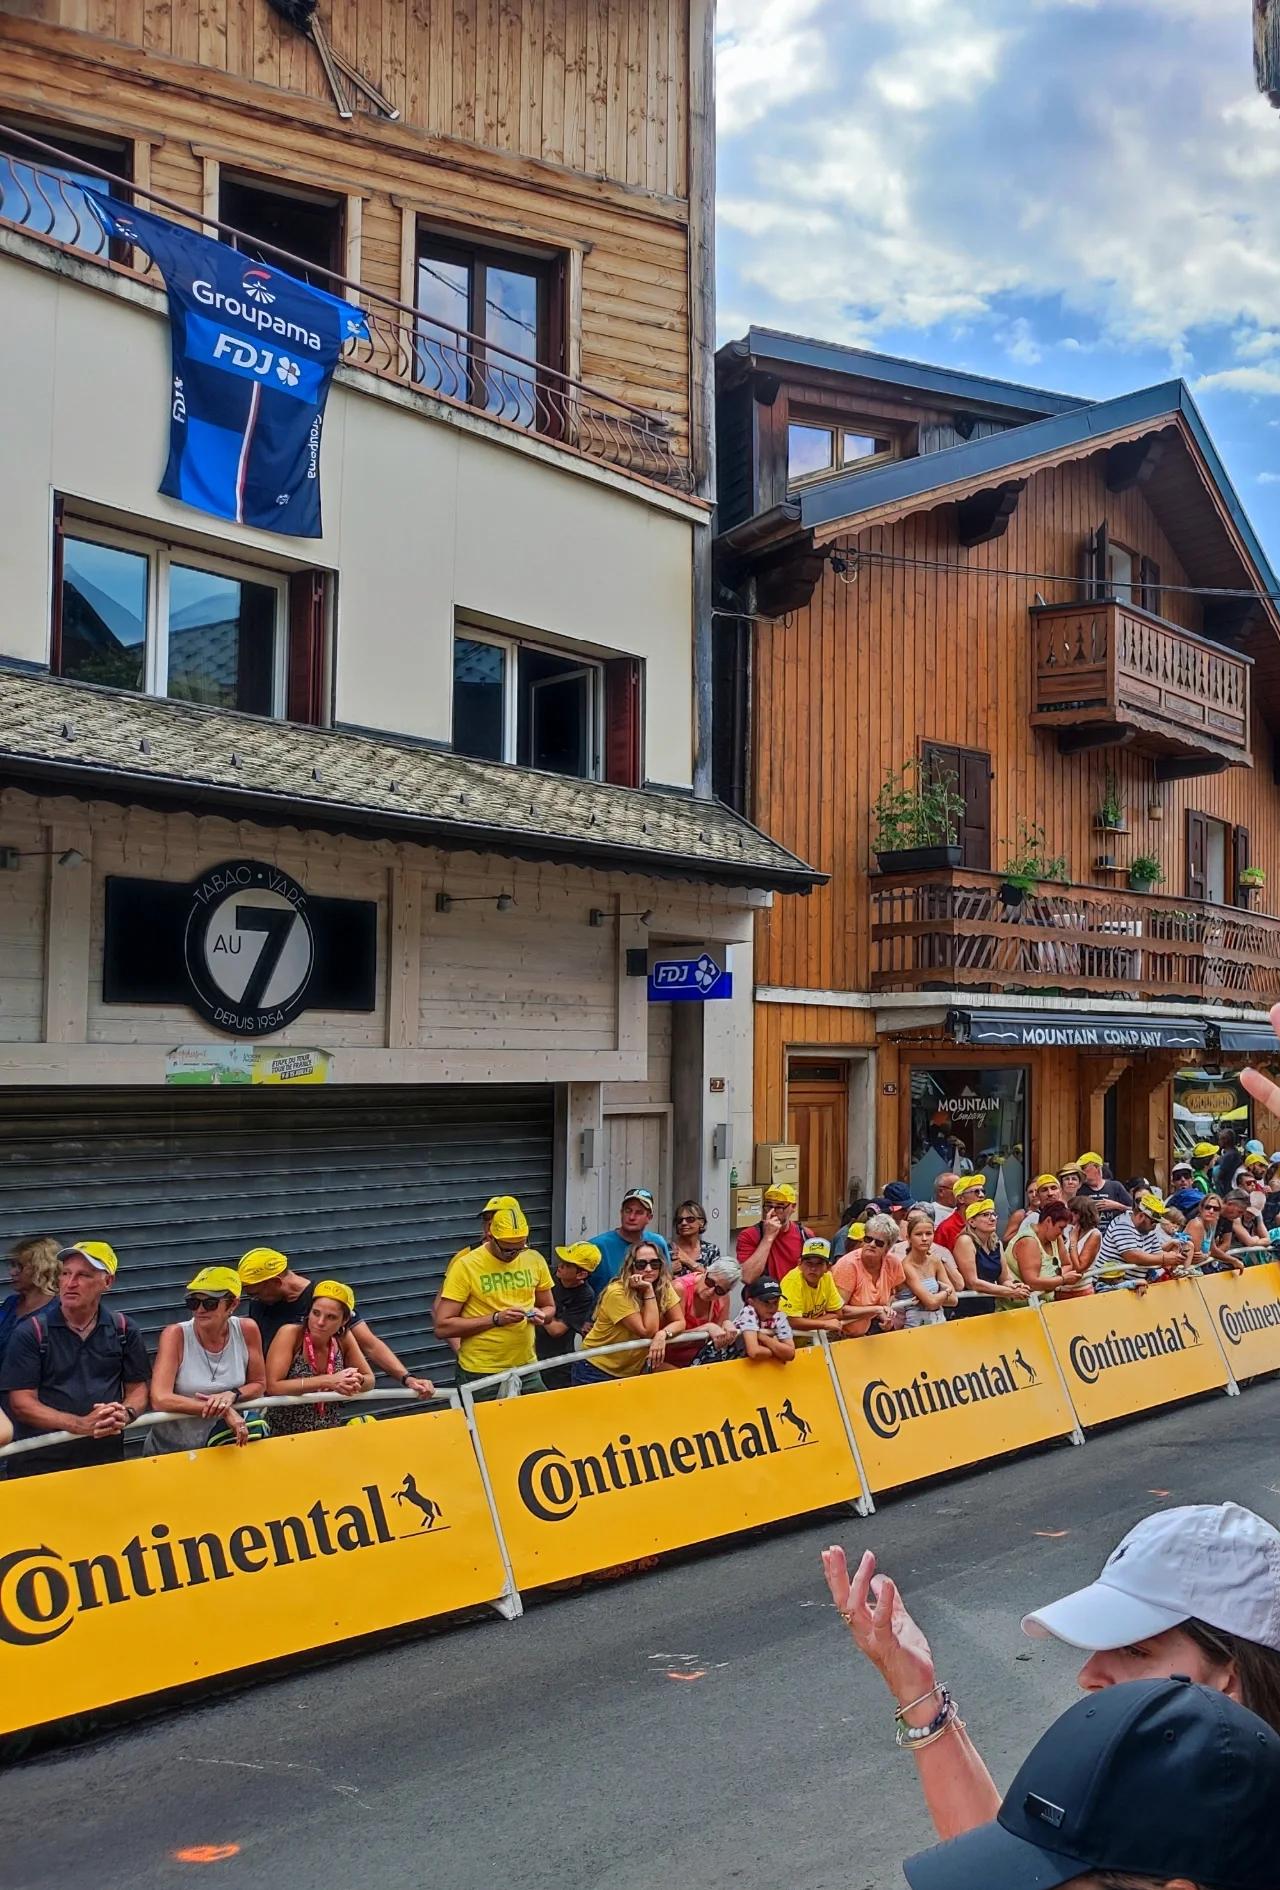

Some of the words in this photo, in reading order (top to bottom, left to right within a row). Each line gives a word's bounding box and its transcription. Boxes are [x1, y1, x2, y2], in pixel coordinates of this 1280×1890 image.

[192, 280, 322, 351] Groupama
[212, 333, 274, 375] FDJ
[172, 391, 187, 424] FDJ
[268, 872, 307, 909] VAPE
[213, 934, 243, 955] AU
[236, 905, 299, 1008] 7
[657, 965, 689, 983] FDJ
[214, 1007, 255, 1030] DEPUIS
[257, 1010, 285, 1029] 1954
[1022, 1028, 1098, 1045] MOUNTAIN
[1104, 1029, 1162, 1047] COMPANY
[938, 1097, 1000, 1112] MOUNTAIN
[951, 1109, 987, 1129] Company
[1070, 1317, 1187, 1385] Continental
[862, 1353, 1020, 1439] Continental
[518, 1406, 782, 1522] Continental
[0, 1484, 396, 1646] Continental
